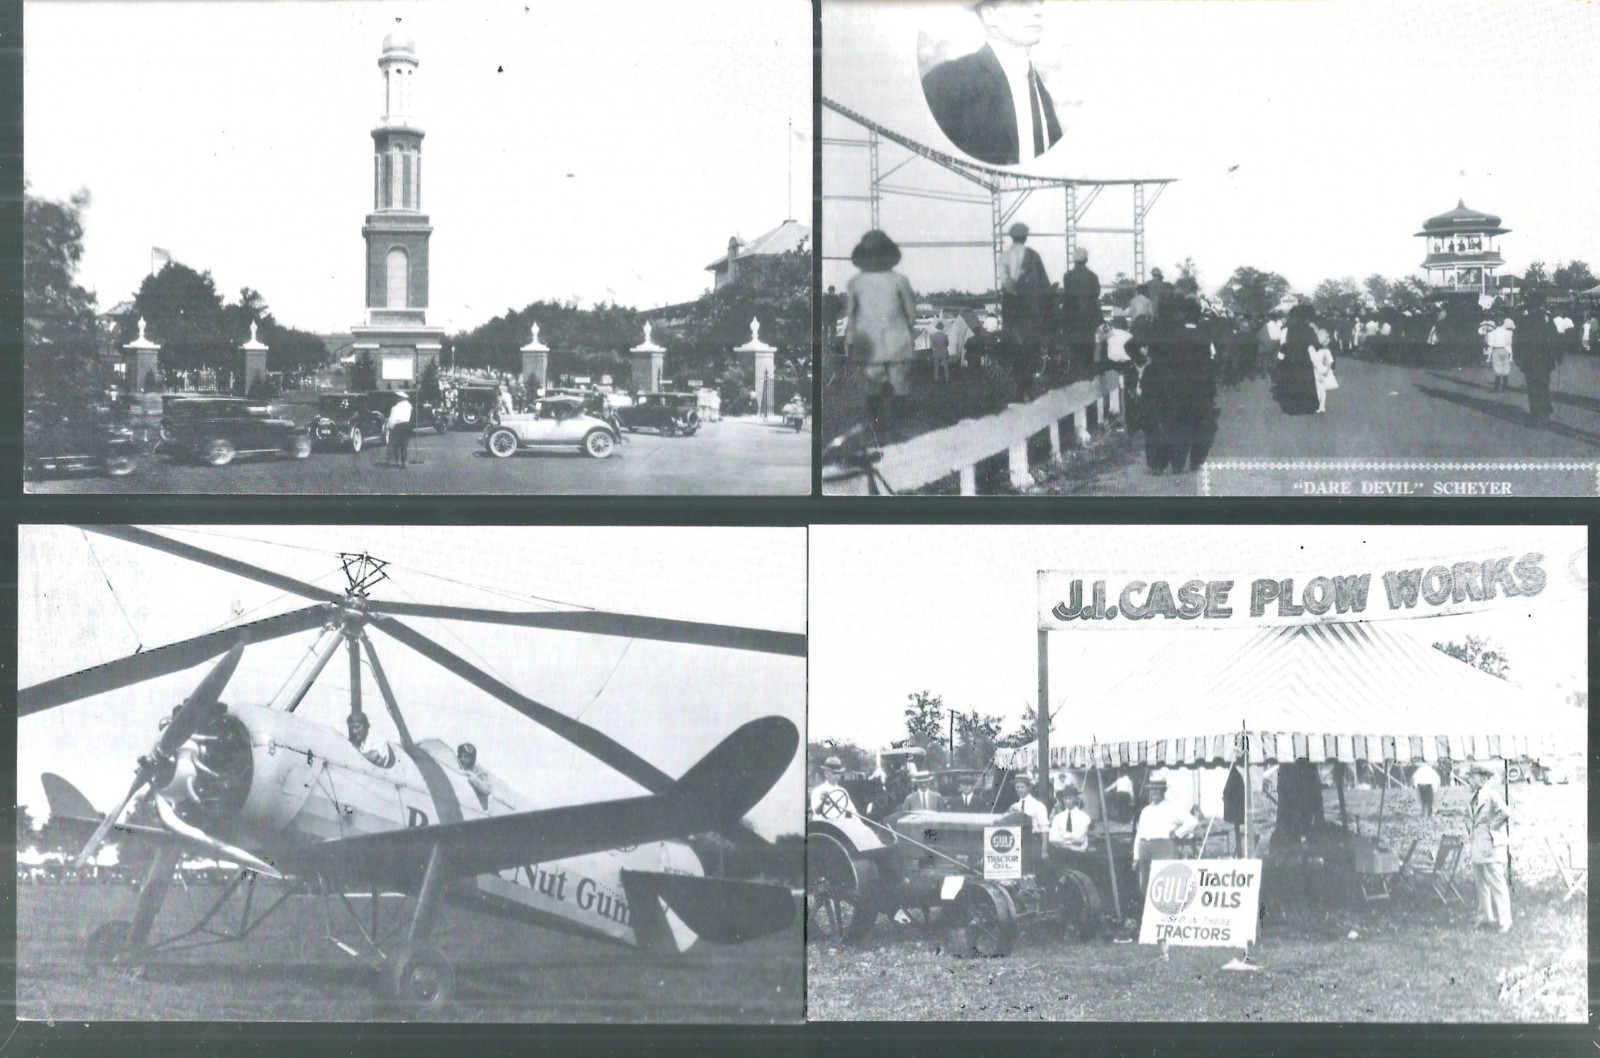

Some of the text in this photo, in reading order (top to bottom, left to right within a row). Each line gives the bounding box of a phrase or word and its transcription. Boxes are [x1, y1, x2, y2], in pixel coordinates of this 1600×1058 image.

[1250, 573, 1371, 617] PLOW
[1382, 552, 1547, 610] WORKS
[993, 835, 1014, 848] GULF
[987, 855, 1019, 863] TRACTOR
[1198, 868, 1254, 888] Tractor
[1150, 876, 1197, 909] GULF
[1200, 891, 1242, 909] OILS
[1202, 917, 1232, 927] THESE
[1155, 924, 1232, 941] TRACTORS
